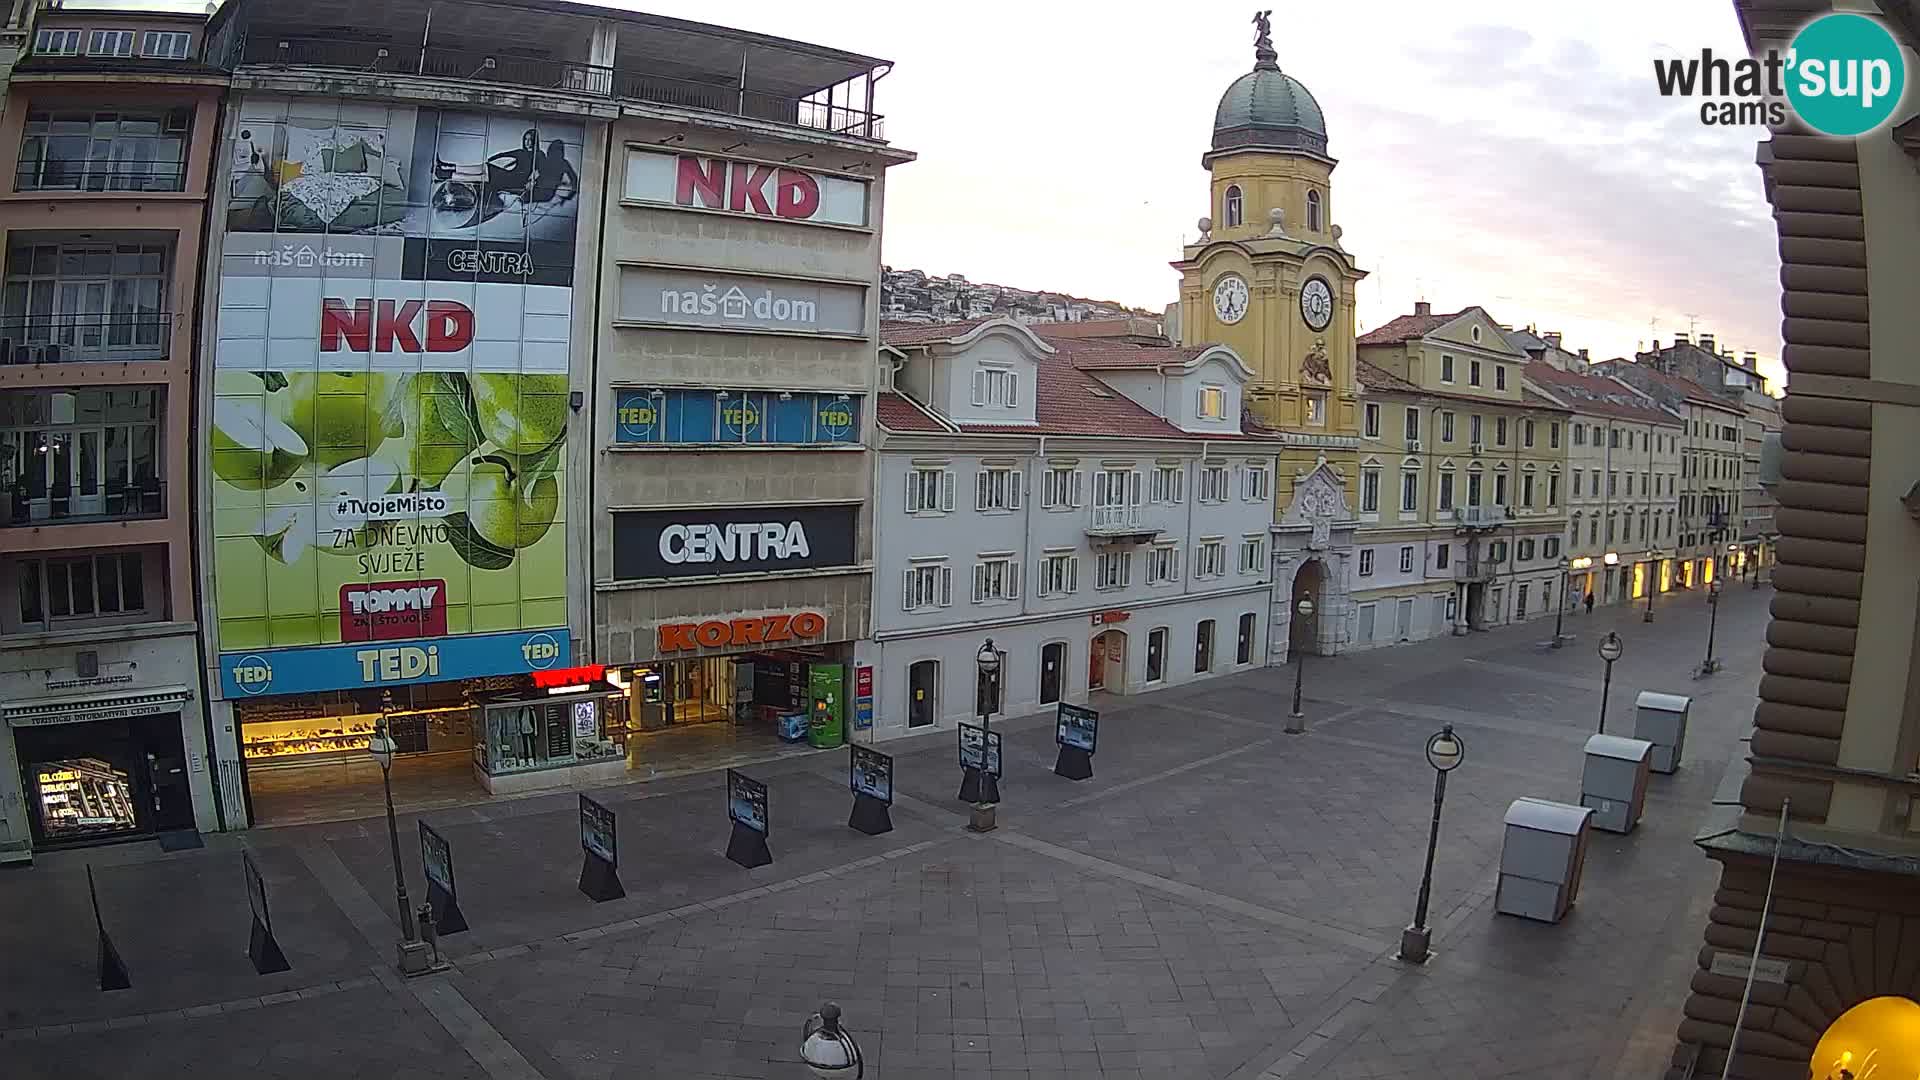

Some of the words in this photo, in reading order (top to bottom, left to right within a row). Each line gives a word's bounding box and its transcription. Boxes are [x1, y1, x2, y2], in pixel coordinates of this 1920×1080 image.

[676, 154, 820, 219] NKD
[254, 245, 292, 266] naš
[319, 247, 365, 268] dom
[447, 249, 534, 275] CENTRA
[662, 283, 718, 316] naš
[754, 290, 816, 322] dom
[320, 299, 474, 352] NKD
[618, 408, 657, 424] TEDi
[723, 408, 759, 425] TEDi
[819, 410, 853, 426] TEDi
[337, 496, 446, 516] #TvojeMisto
[333, 528, 357, 548] ZA
[365, 523, 449, 548] DNEVNO
[659, 520, 810, 564] CENTRA
[358, 546, 425, 575] SVJEŽE
[347, 587, 439, 614] TOMMY
[659, 612, 825, 653] KORZO
[522, 642, 560, 660] TEDi
[233, 665, 272, 685] TEDi
[357, 645, 439, 683] TEDi
[131, 704, 161, 717] CENTAR
